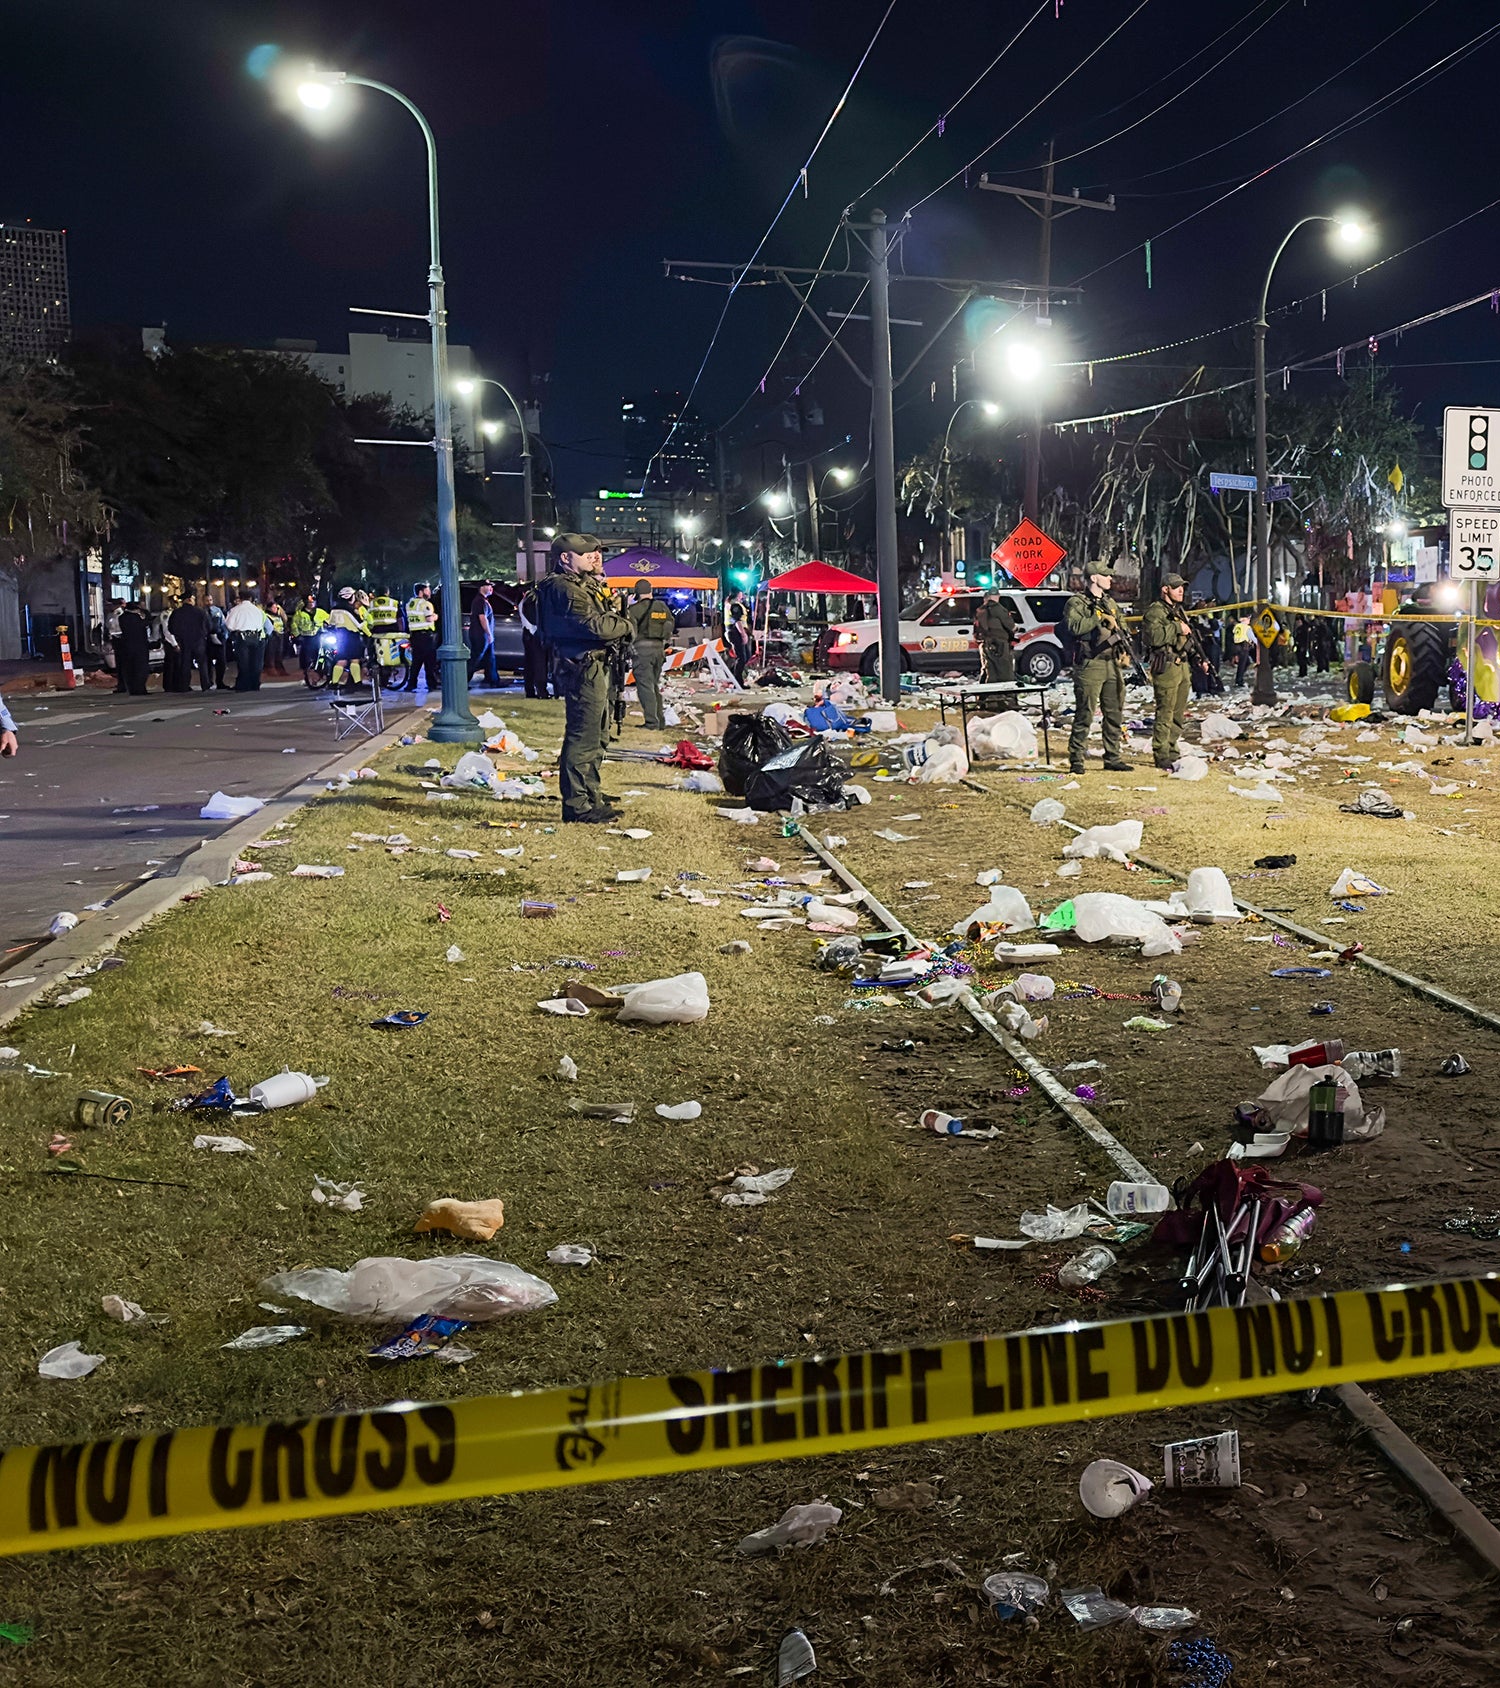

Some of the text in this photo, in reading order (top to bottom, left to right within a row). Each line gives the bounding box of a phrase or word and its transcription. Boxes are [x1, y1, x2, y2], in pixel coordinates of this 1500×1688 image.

[1460, 475, 1494, 487] PHOTO
[1456, 518, 1498, 530] SPEED
[1013, 537, 1042, 546] ROAD
[1460, 533, 1493, 543] LIMIT
[1015, 550, 1043, 559] WORK
[1458, 547, 1494, 571] 35
[1013, 563, 1047, 571] AHEAD
[939, 638, 970, 651] FIRE
[665, 1347, 943, 1456] SHERIFF
[970, 1327, 1110, 1417] LINE
[1131, 1309, 1214, 1394] DO
[1233, 1297, 1343, 1379] NOT
[29, 1404, 456, 1532] NOT CROSS
